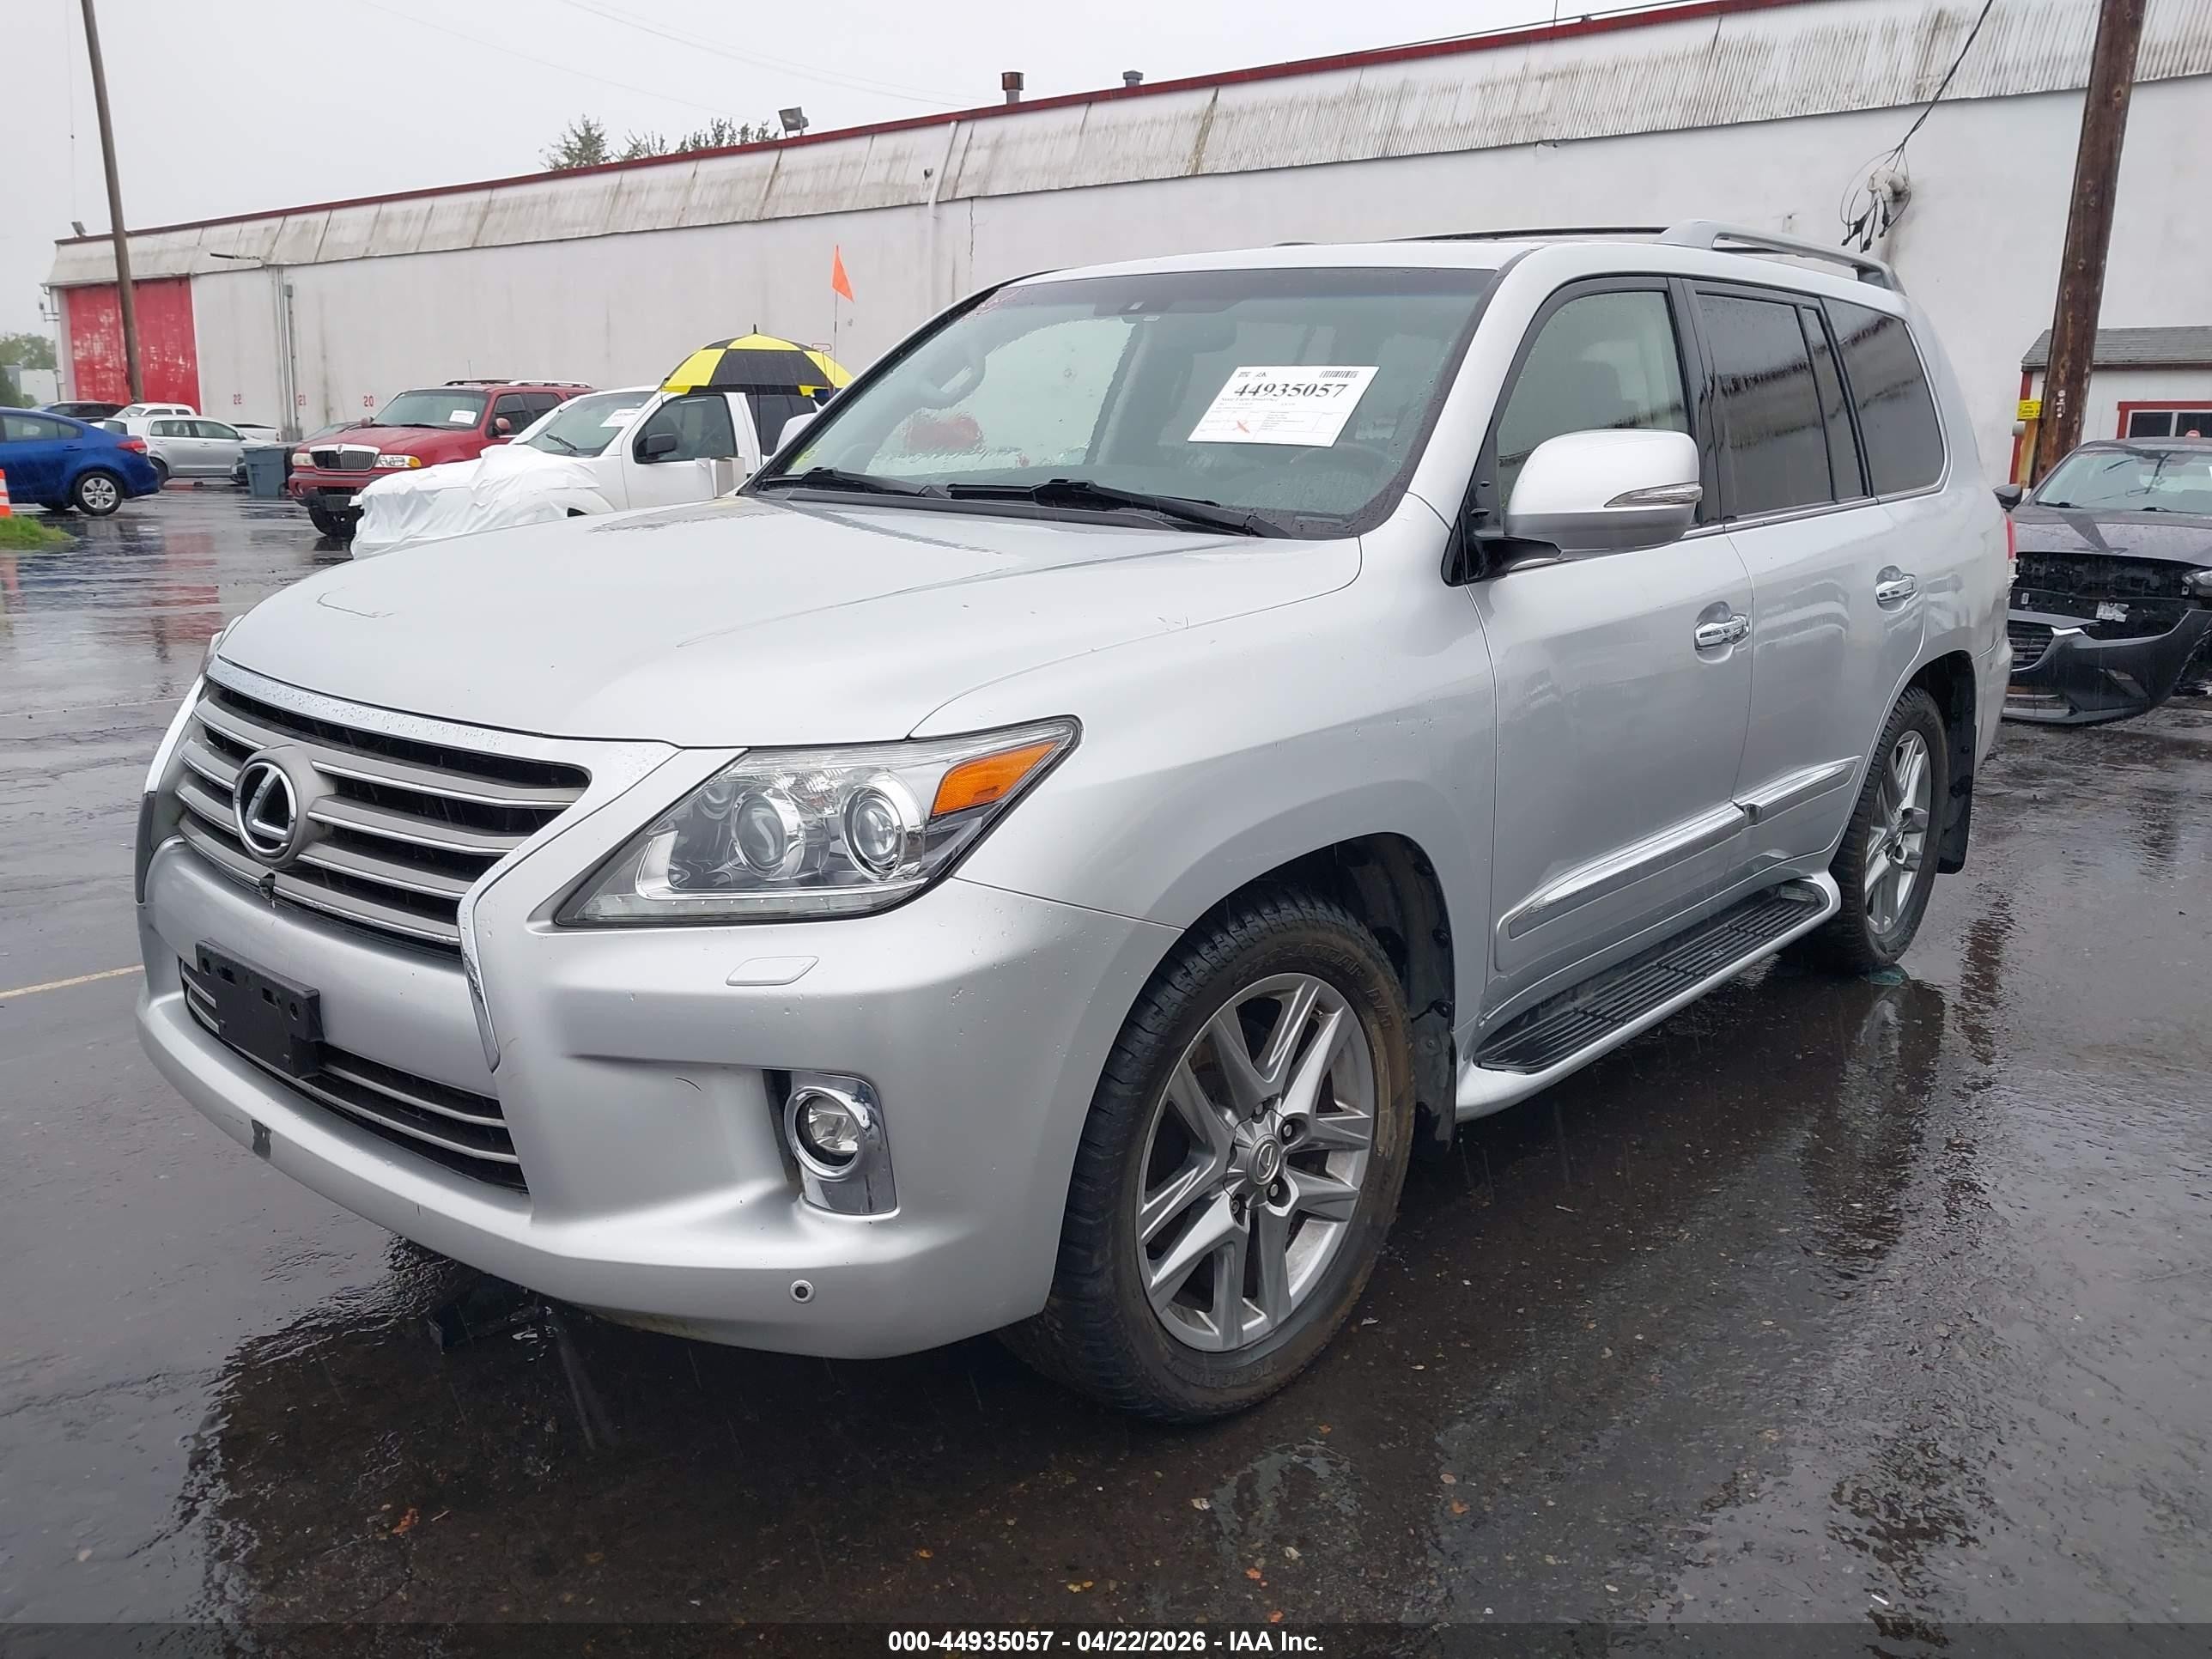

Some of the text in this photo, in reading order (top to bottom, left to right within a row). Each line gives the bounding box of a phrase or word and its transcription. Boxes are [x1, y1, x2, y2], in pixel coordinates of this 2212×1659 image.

[1234, 383, 1348, 398] 44935057
[233, 394, 243, 405] 22
[298, 395, 307, 406] 21
[363, 396, 374, 407] 20
